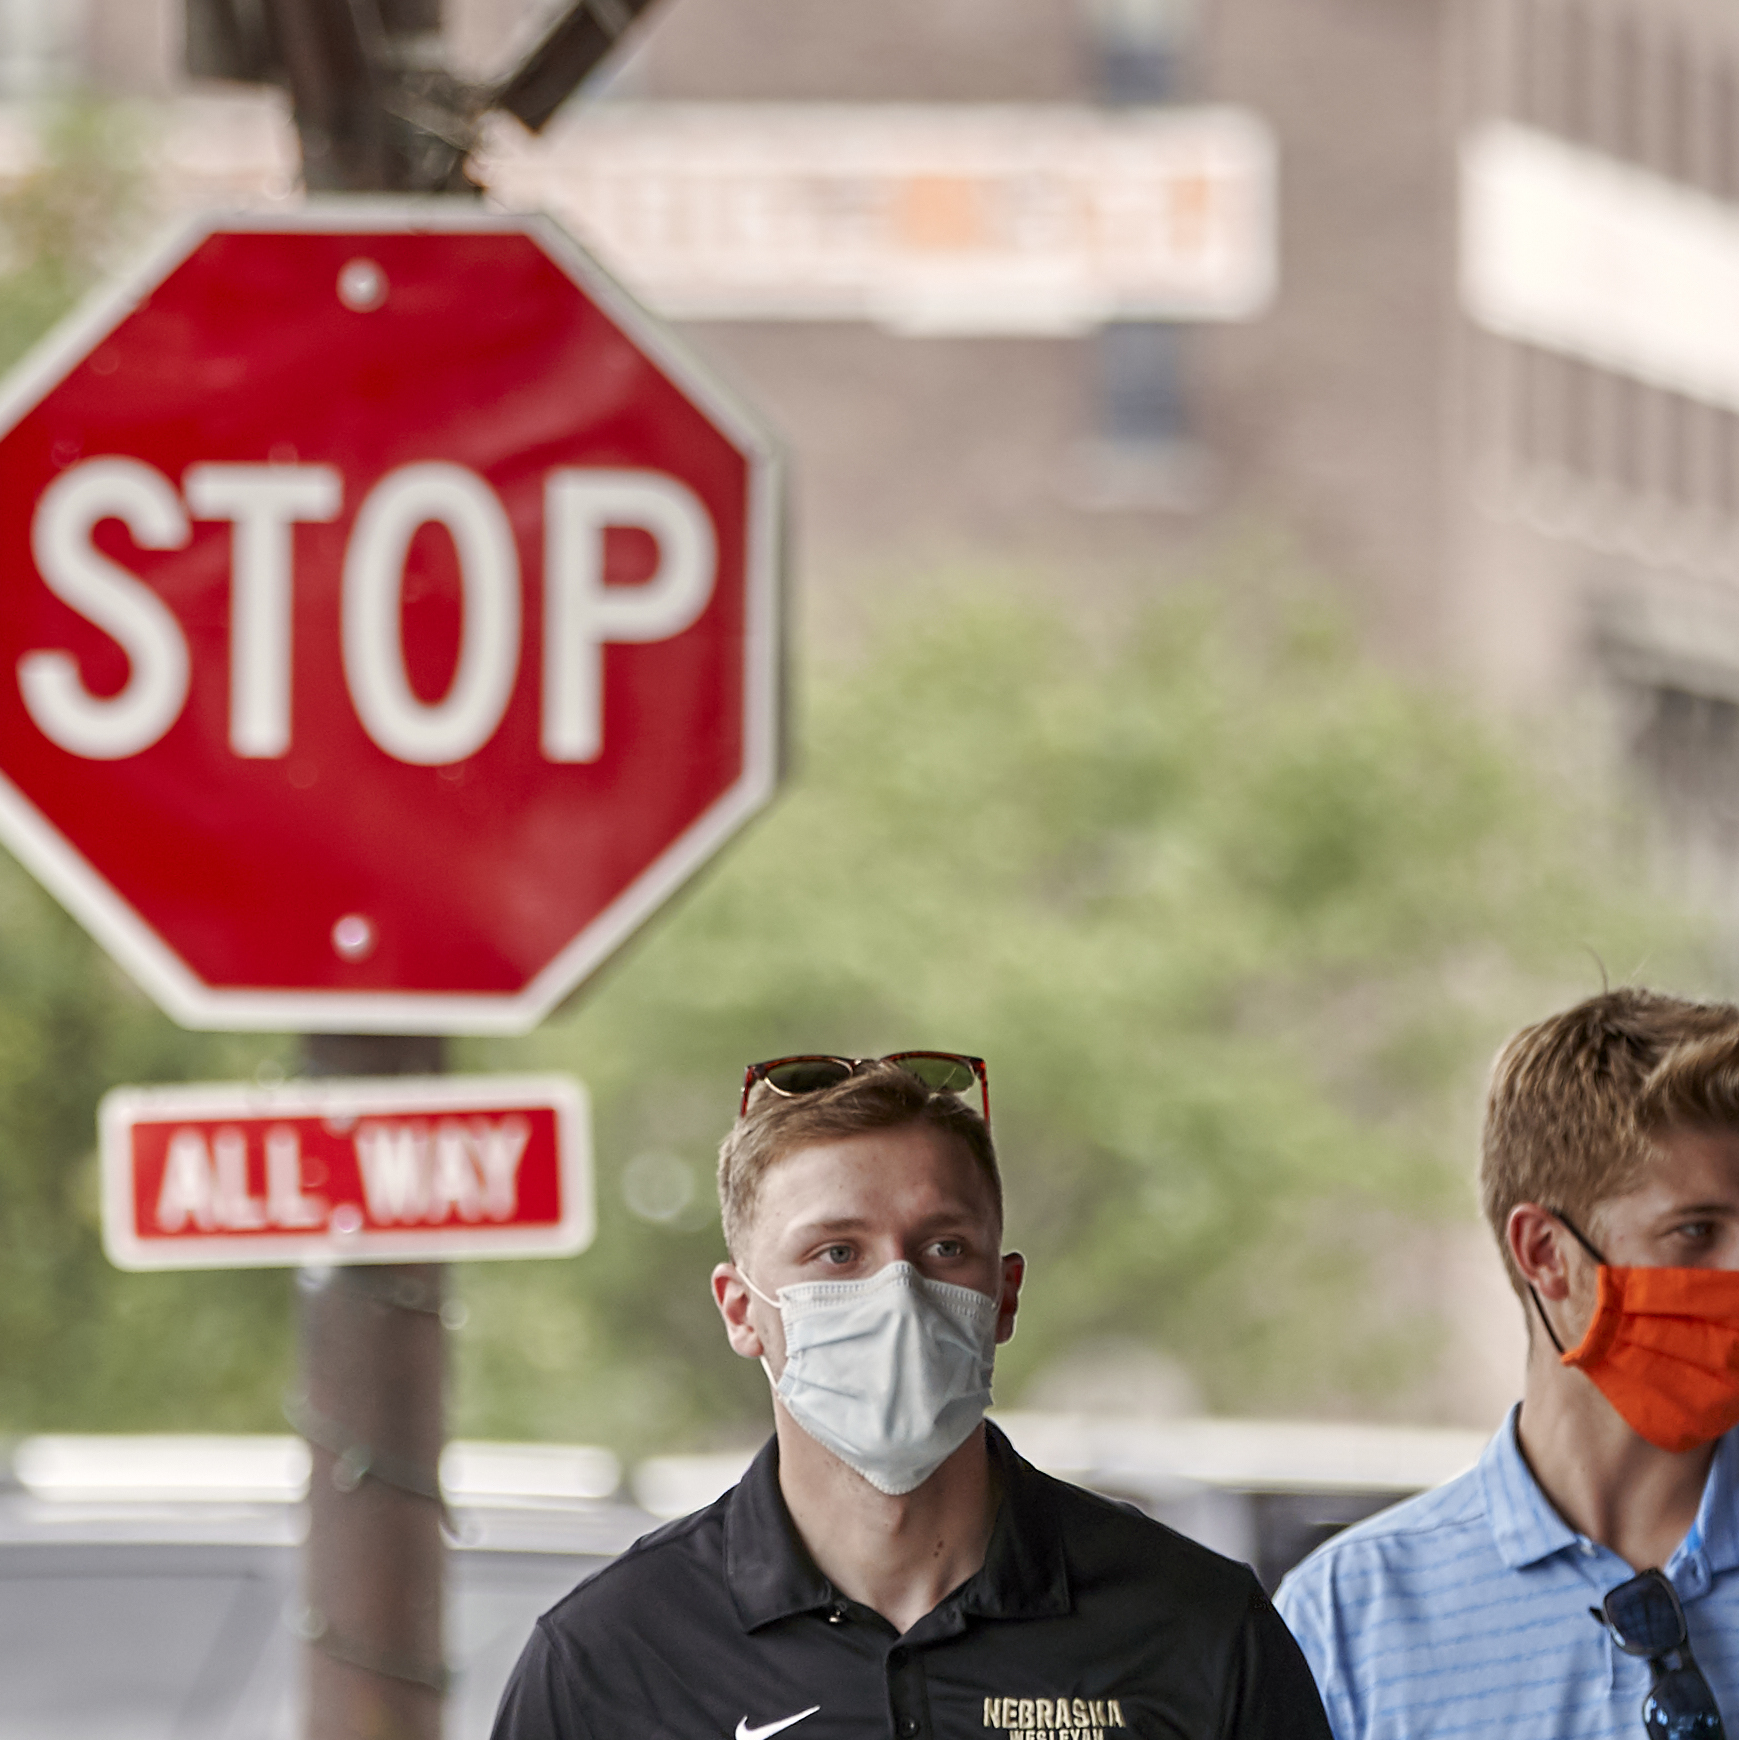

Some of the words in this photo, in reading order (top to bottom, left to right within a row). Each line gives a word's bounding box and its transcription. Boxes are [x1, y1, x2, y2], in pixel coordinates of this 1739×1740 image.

[16, 453, 720, 766] STOP
[156, 1125, 330, 1234] ALL
[353, 1112, 534, 1227] WAY
[983, 1696, 1127, 1730] NEBRASKA
